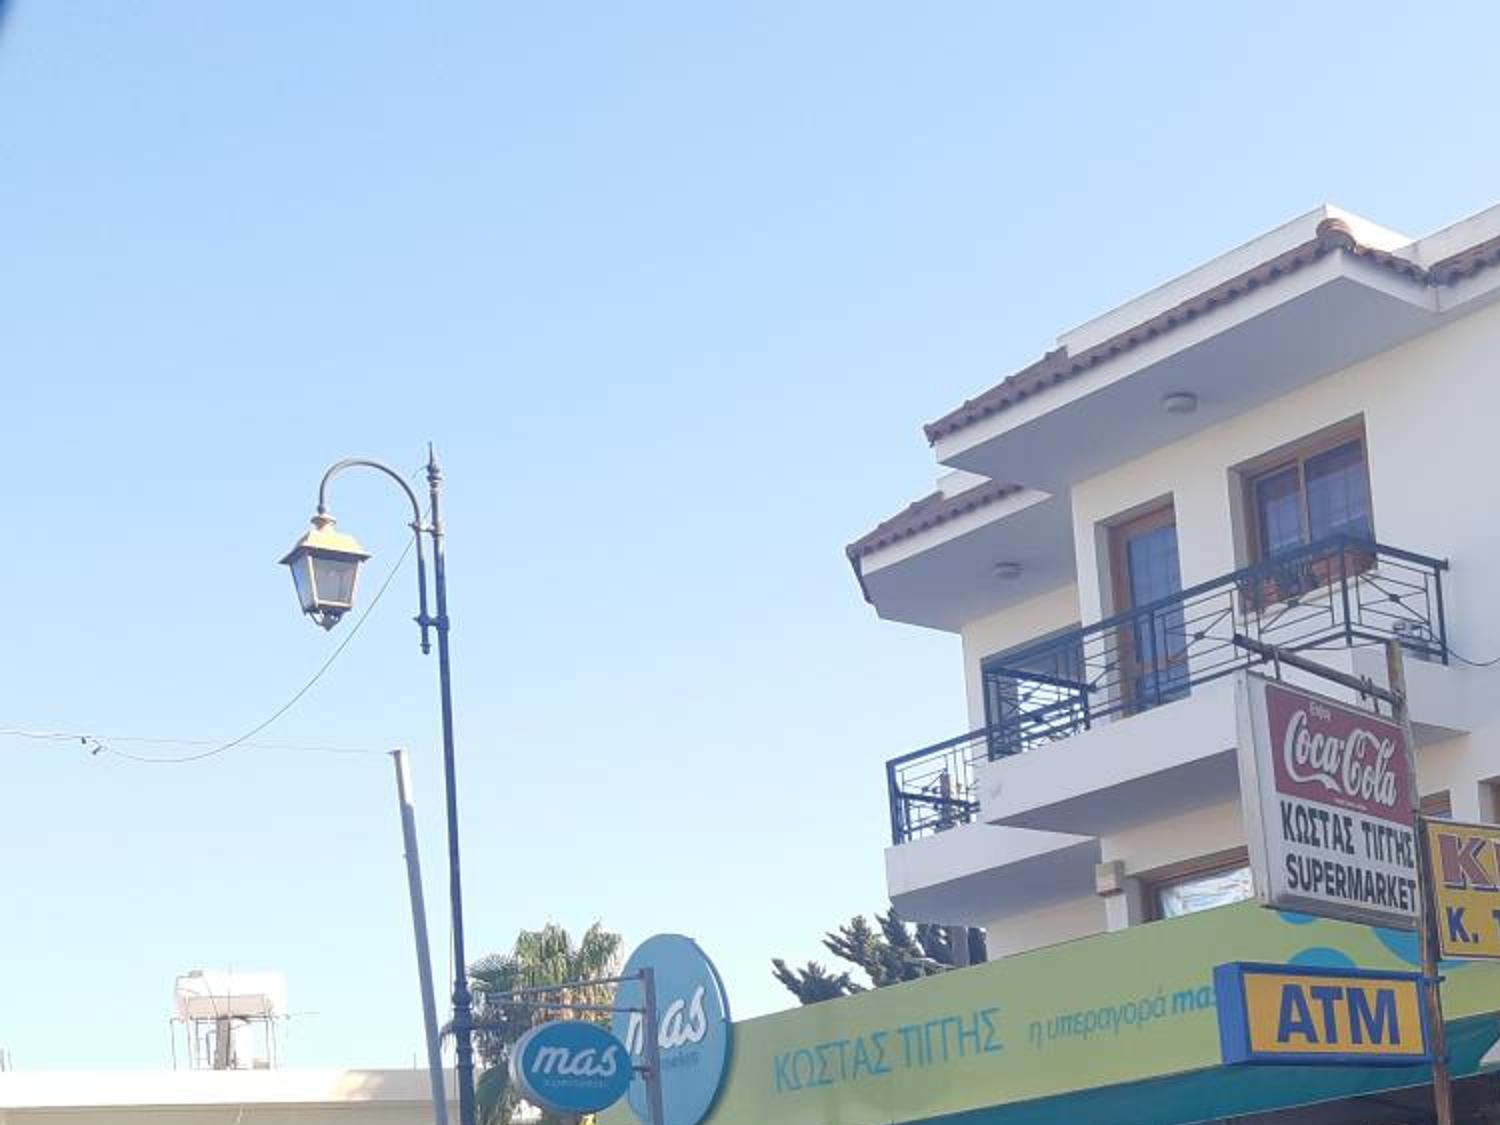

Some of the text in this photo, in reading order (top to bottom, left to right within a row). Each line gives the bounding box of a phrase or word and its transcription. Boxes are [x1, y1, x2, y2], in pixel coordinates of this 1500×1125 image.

[1280, 801, 1414, 868] ΚΩΣΤΑΣ ΤΙΓΓΗΣ
[1285, 854, 1416, 912] SUPERMARKET
[1446, 907, 1479, 943] K.
[1277, 984, 1400, 1045] ATM
[531, 1045, 617, 1077] mas
[774, 1029, 892, 1092] ΚΩΣΤΑΣ
[896, 1008, 1002, 1069] ΤΙΓΓΗΣ
